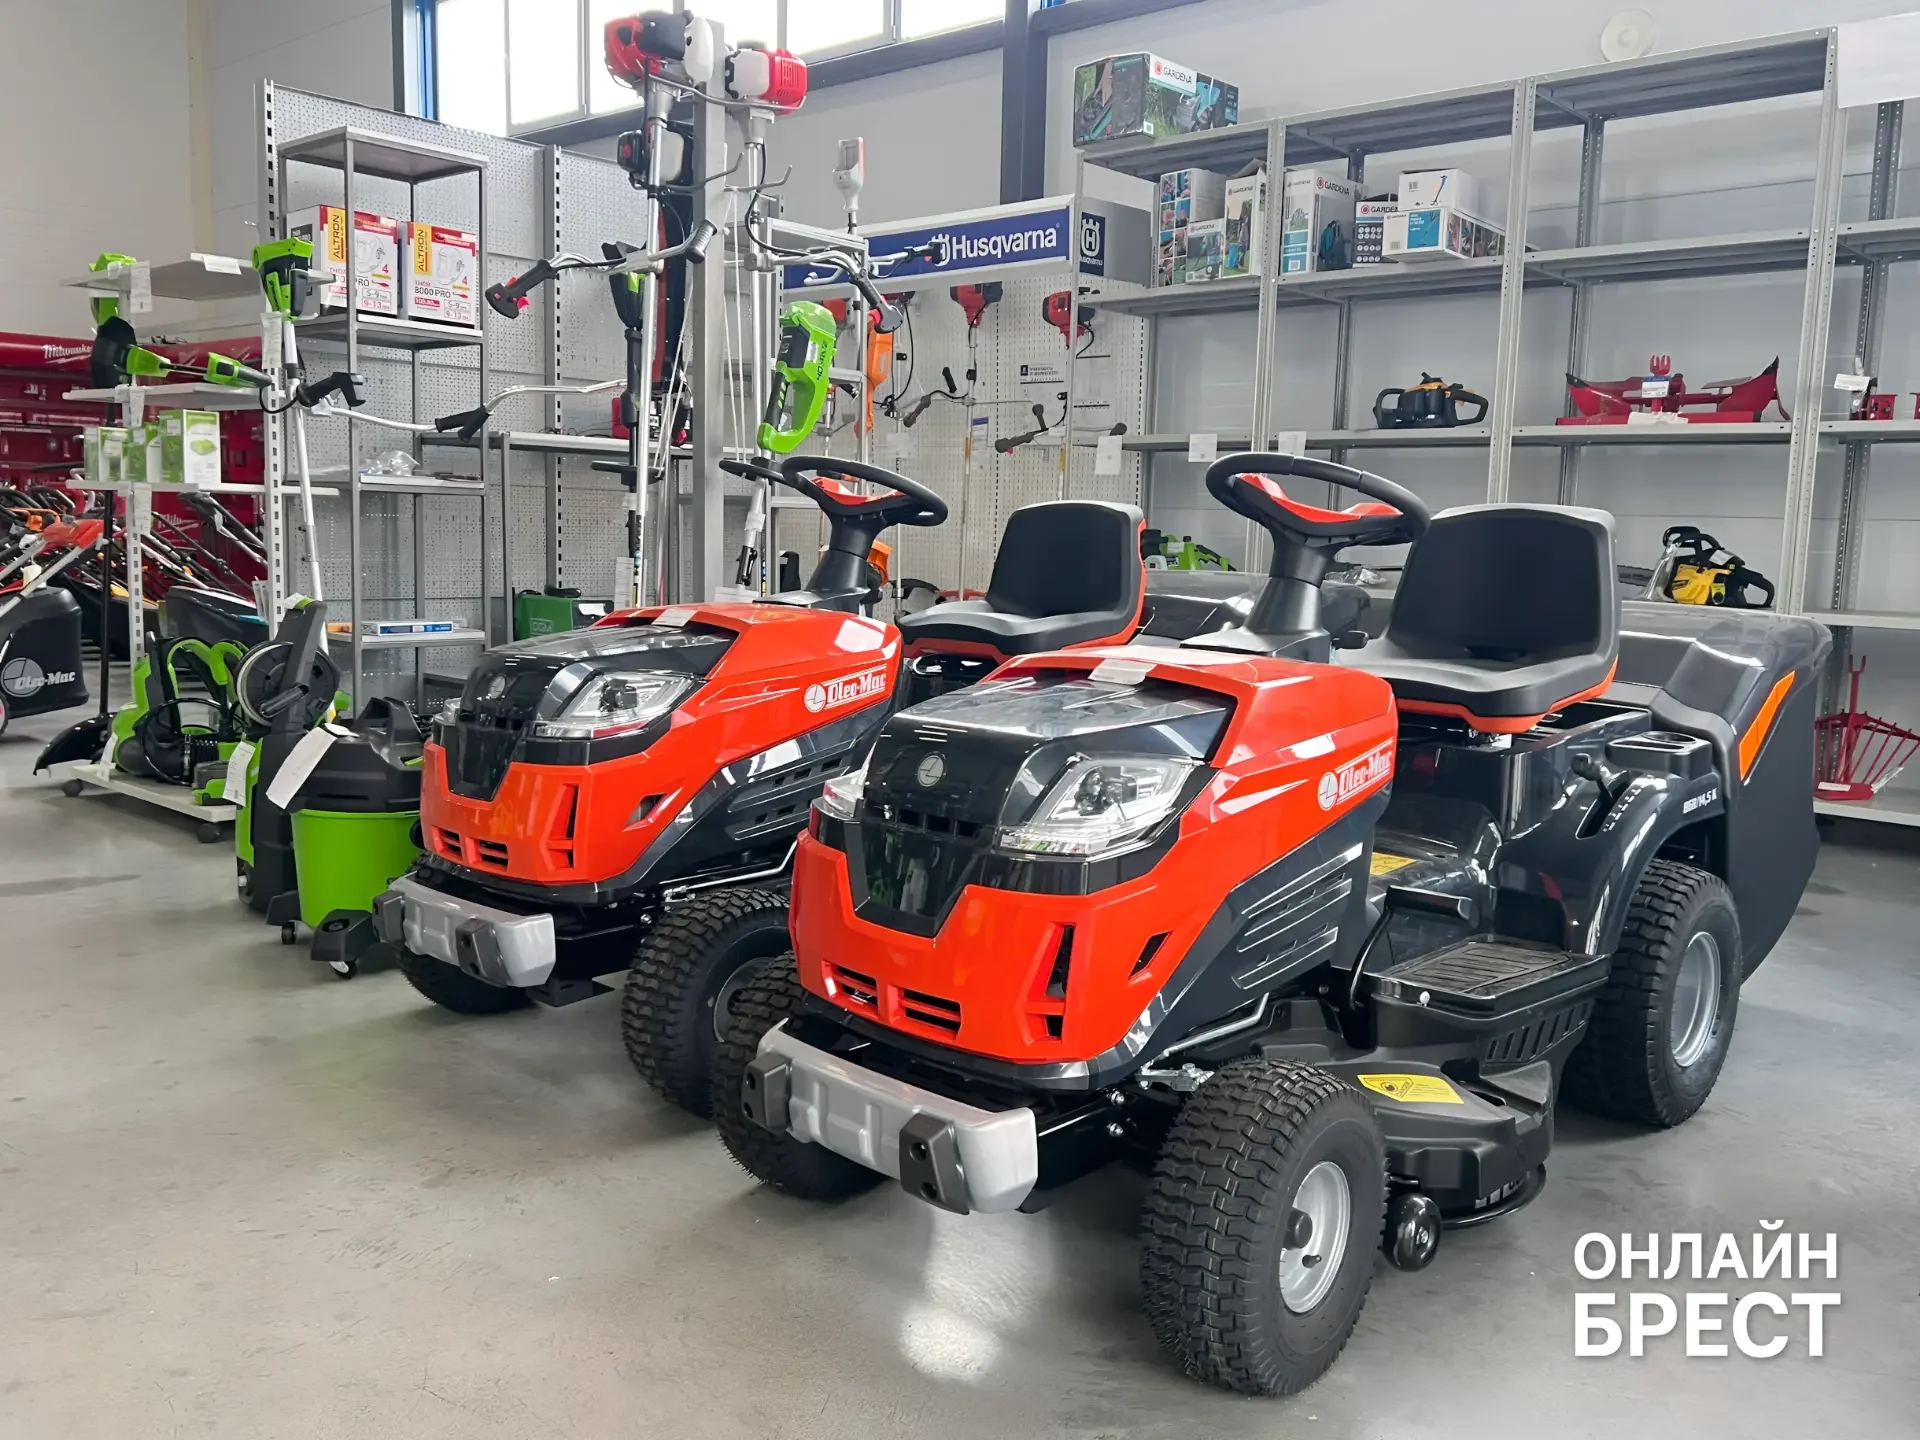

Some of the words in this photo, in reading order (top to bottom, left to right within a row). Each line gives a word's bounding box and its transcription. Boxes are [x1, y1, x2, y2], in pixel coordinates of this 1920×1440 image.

[1163, 66, 1192, 84] GARDENA
[1324, 181, 1350, 195] GARDENA
[417, 229, 425, 272] ALTRON
[951, 226, 1057, 260] Husqvarna
[356, 279, 370, 287] RO
[415, 286, 434, 296] 8000
[435, 289, 451, 298] PRO
[42, 344, 93, 360] Milwauke
